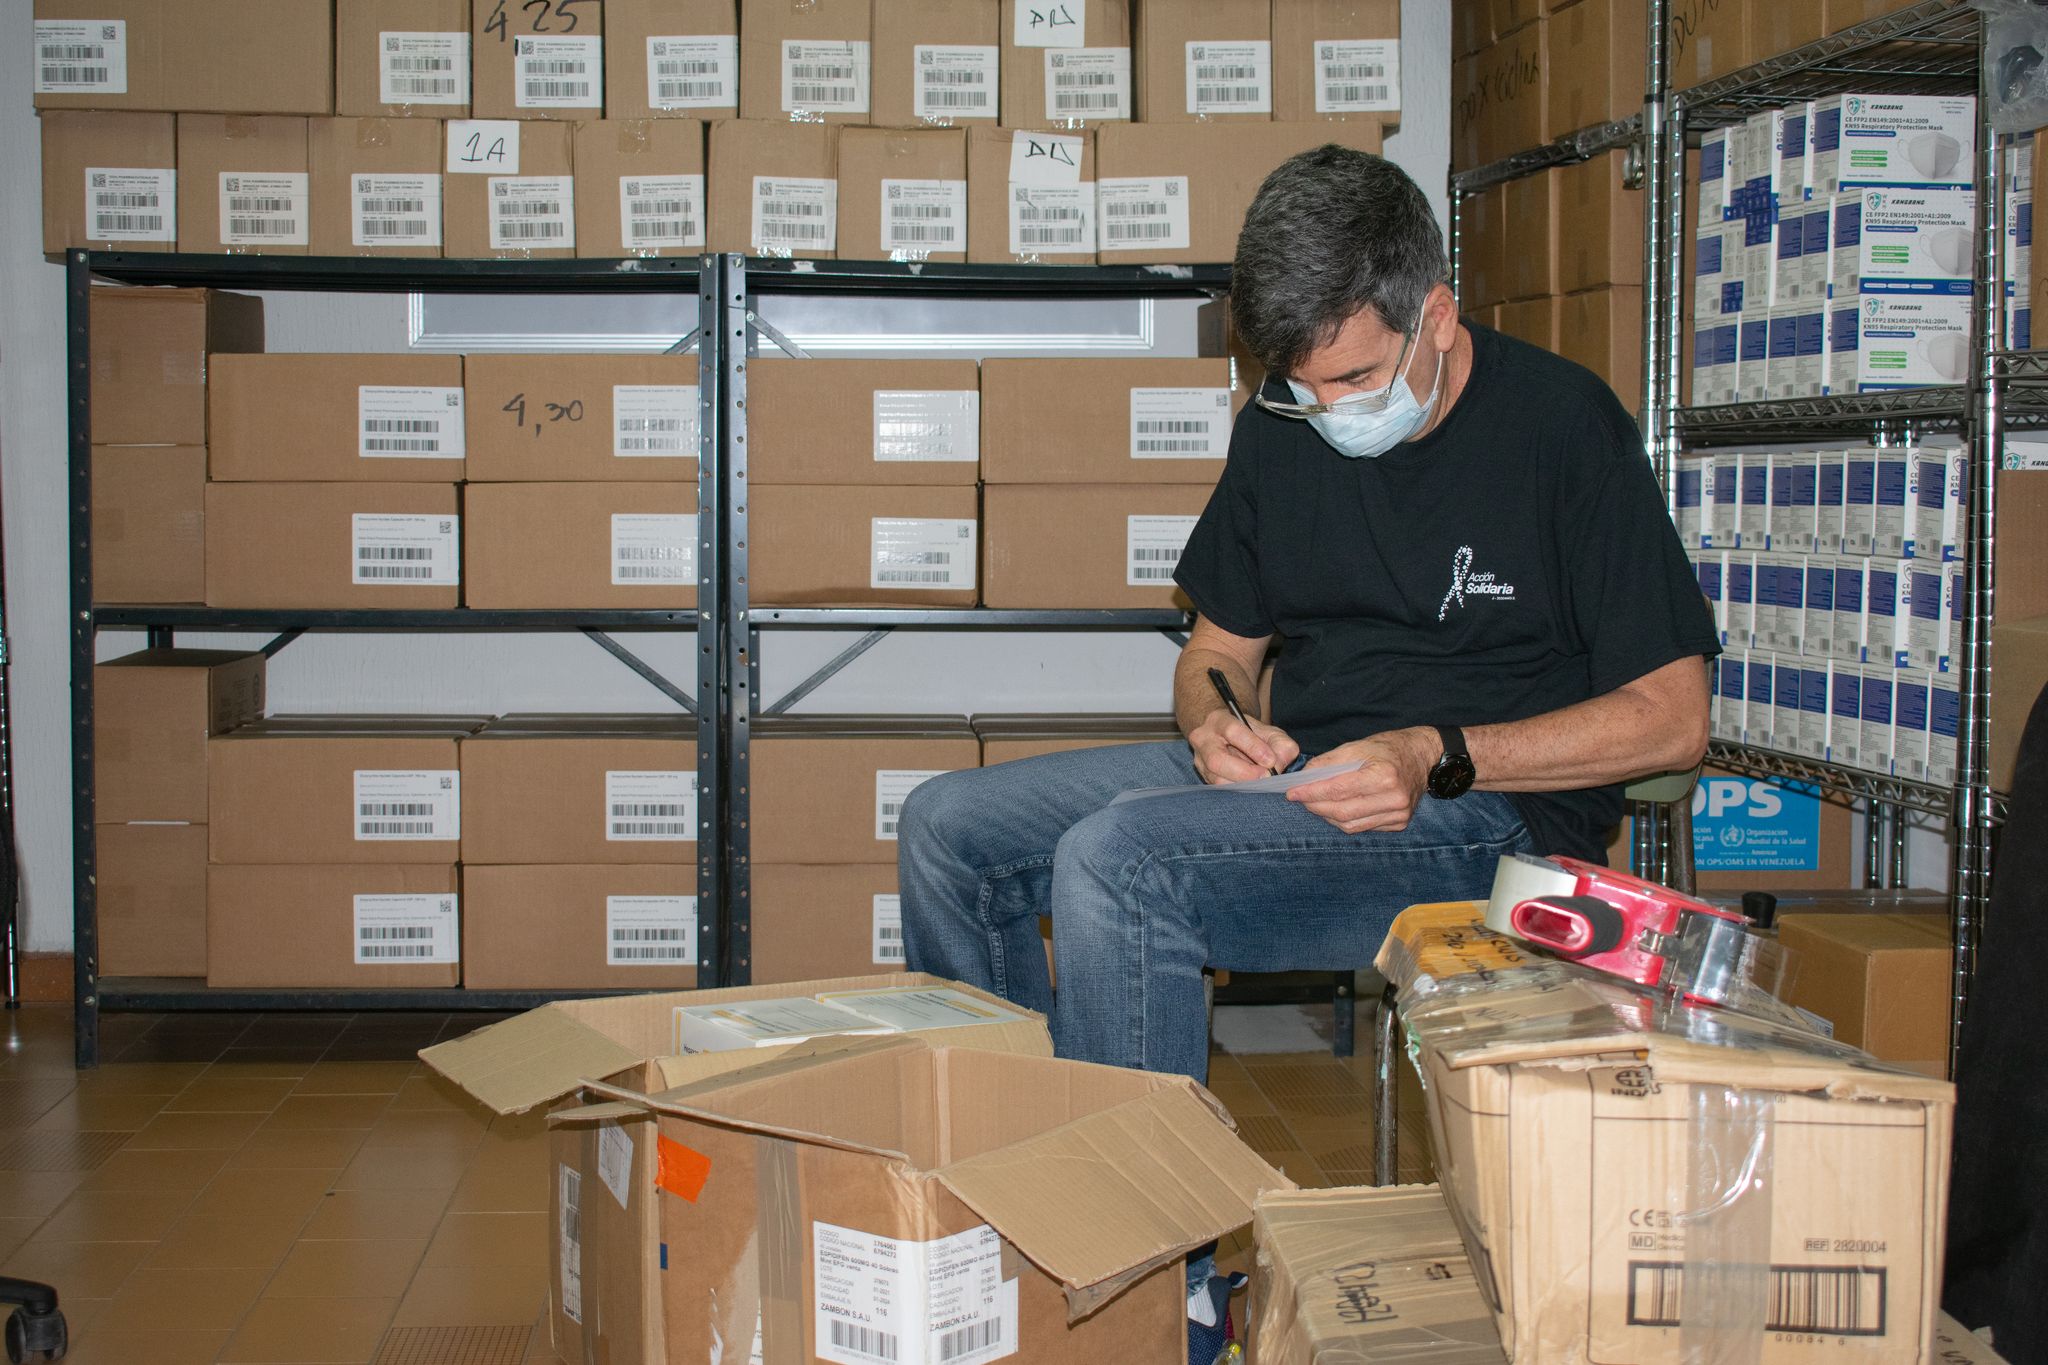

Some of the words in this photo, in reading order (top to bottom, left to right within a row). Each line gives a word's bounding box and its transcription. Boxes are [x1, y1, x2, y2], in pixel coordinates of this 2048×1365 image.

[1467, 571, 1495, 582] Acción
[1465, 582, 1514, 595] Solidaria
[1759, 858, 1806, 866] VENEZUELA
[1631, 1235, 1654, 1248] MD
[1805, 1240, 1827, 1249] REF
[1833, 1240, 1887, 1253] 2820004
[821, 1302, 851, 1317] ZAMBON
[929, 1317, 960, 1332] ZAMBON
